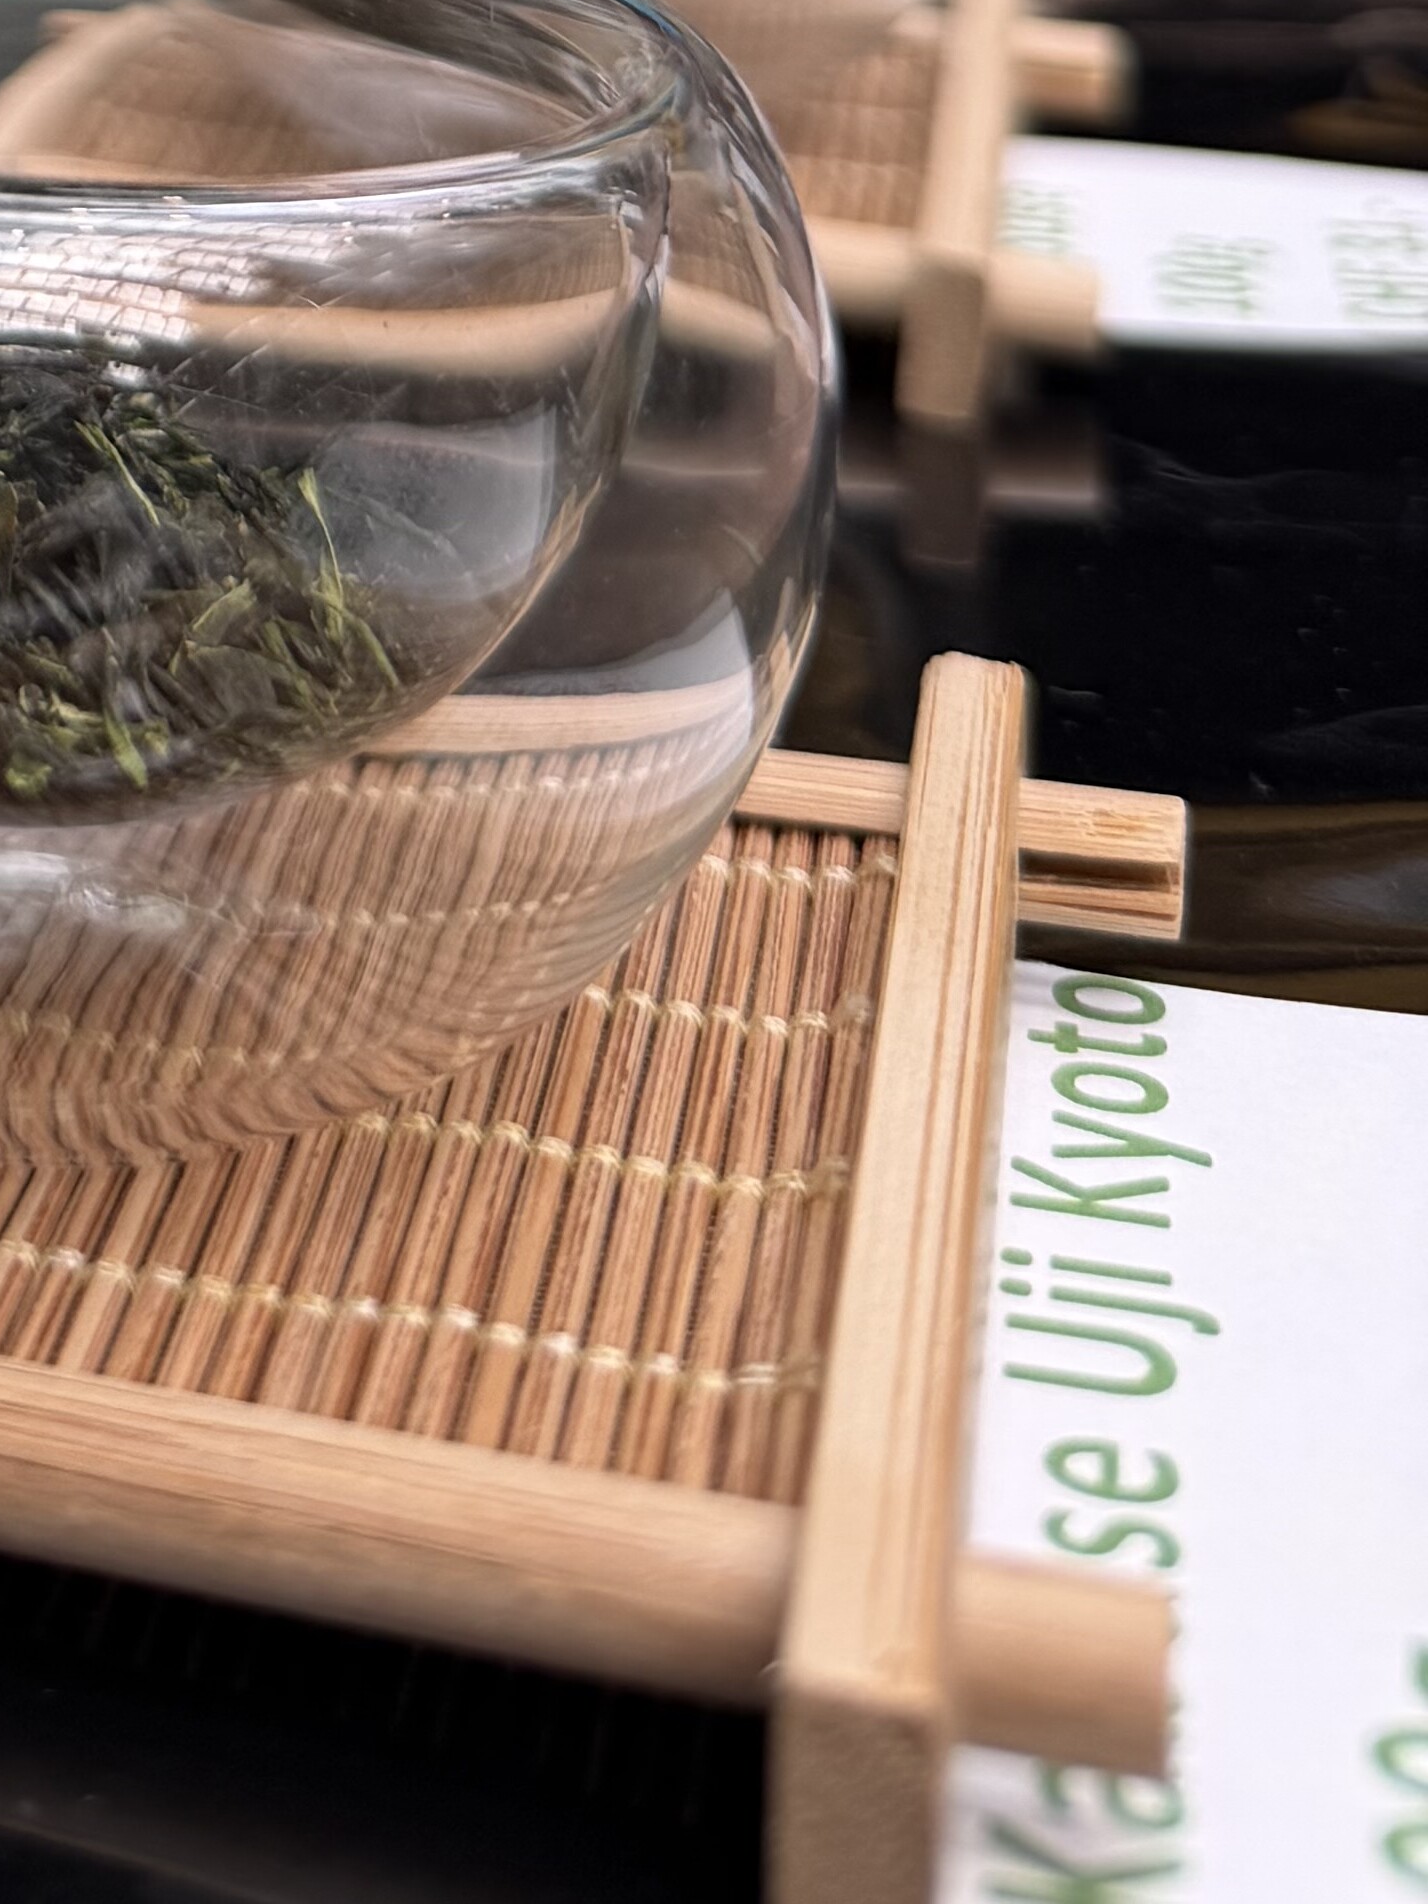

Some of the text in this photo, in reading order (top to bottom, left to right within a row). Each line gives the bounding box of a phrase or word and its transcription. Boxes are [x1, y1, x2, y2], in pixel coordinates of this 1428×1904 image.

[982, 975, 1221, 1904] Kase Uji Kyoto
